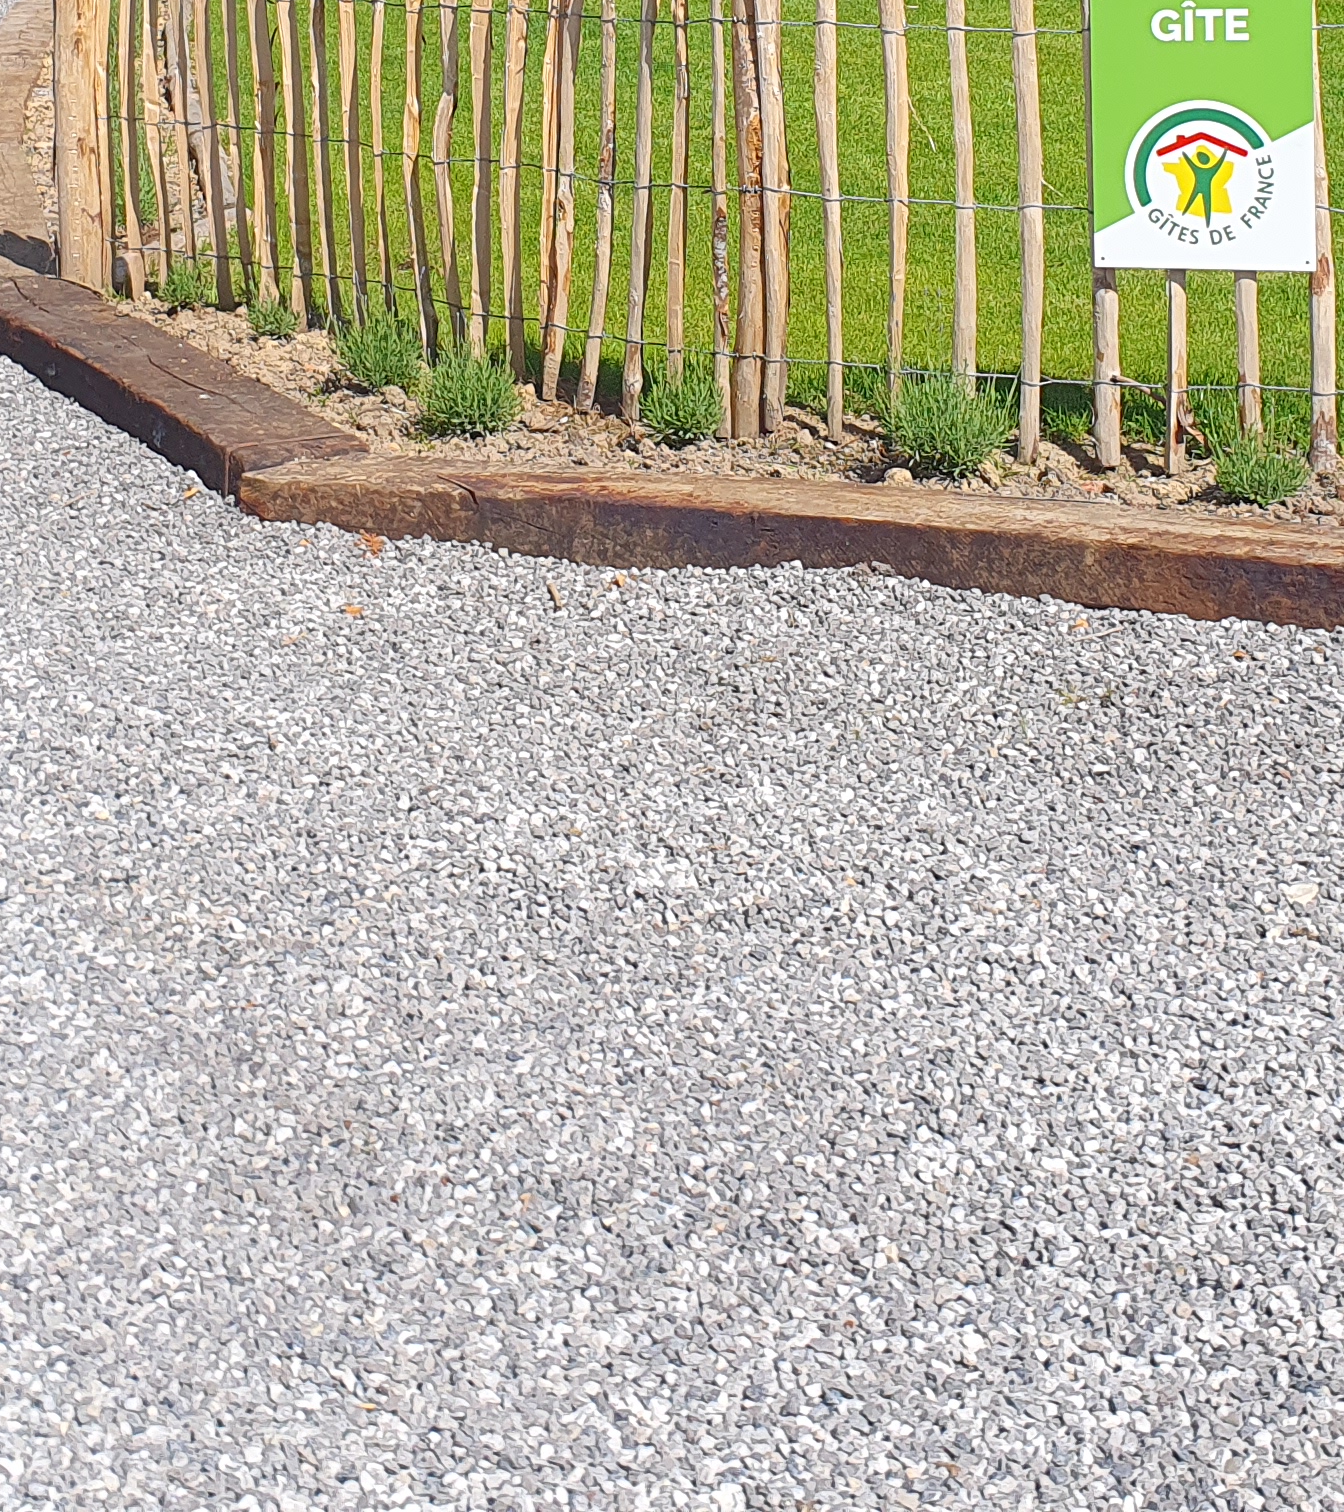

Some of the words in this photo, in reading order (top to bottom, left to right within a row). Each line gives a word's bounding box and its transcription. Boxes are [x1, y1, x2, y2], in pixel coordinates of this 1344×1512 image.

[1150, 0, 1250, 42] GÎTE
[1148, 208, 1200, 245] GÎTES
[1209, 225, 1236, 245] DE
[1240, 154, 1275, 230] FRANCE
